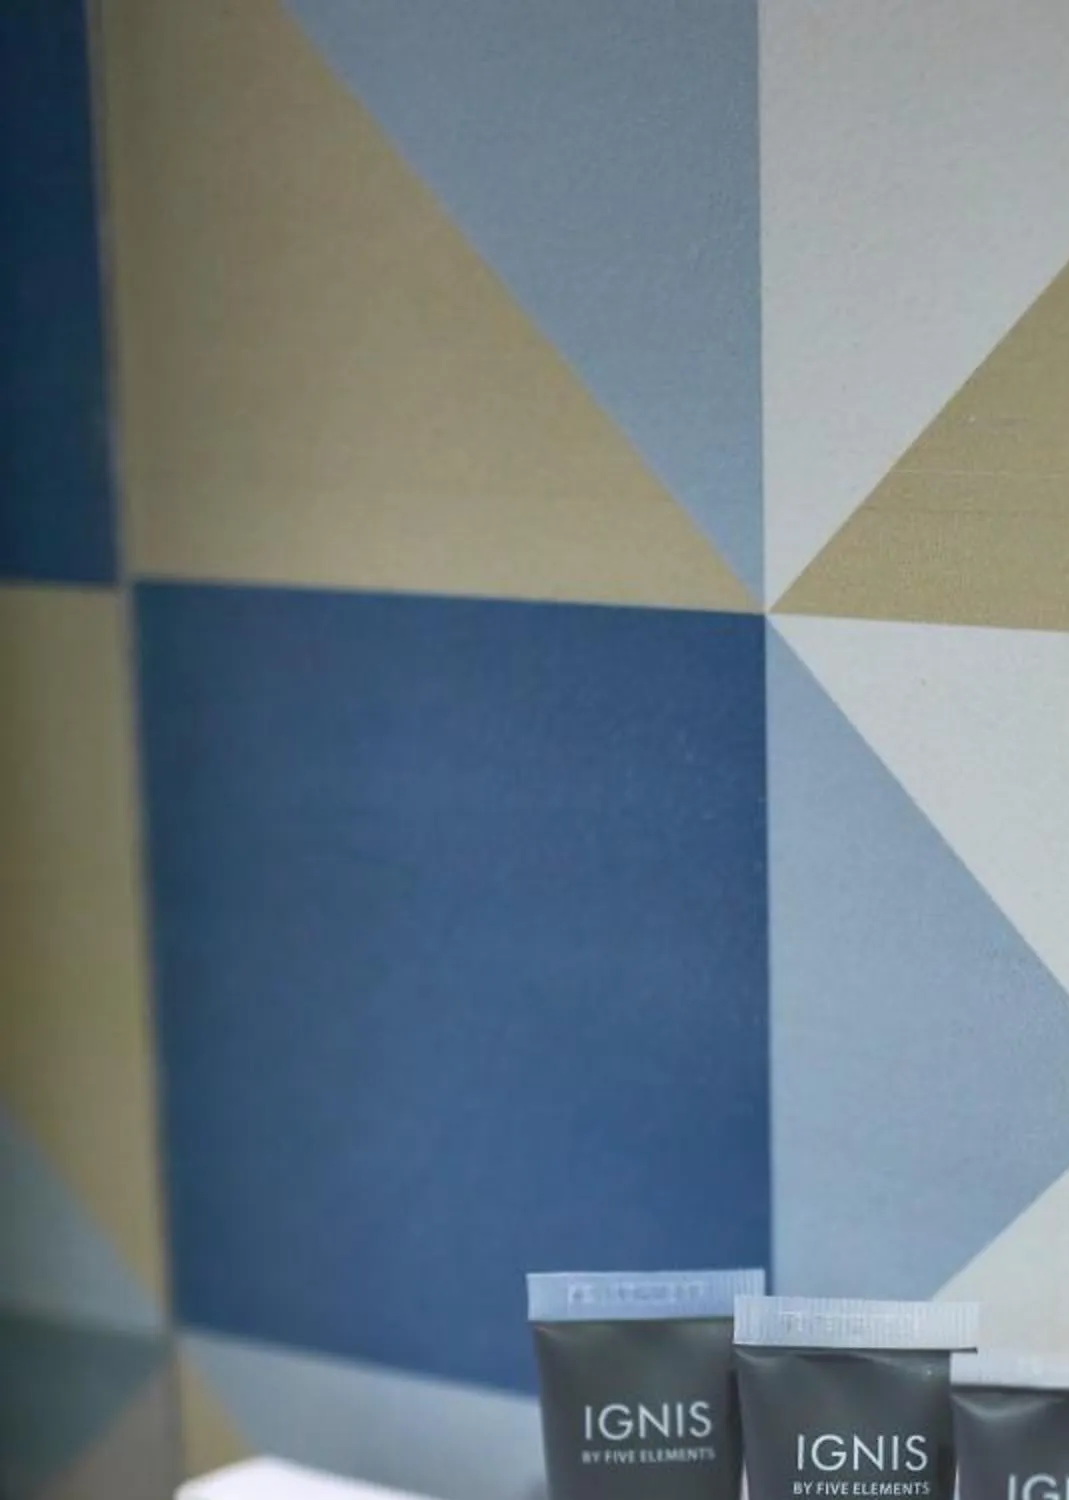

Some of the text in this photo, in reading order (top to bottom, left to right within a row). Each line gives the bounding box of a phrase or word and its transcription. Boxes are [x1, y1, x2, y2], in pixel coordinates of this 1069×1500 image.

[584, 1401, 712, 1441] IGNIS
[582, 1446, 716, 1464] BY FIVE ELEMENTS
[797, 1433, 928, 1471] IGNIS
[793, 1481, 930, 1496] BY FIVE ELEMENTS
